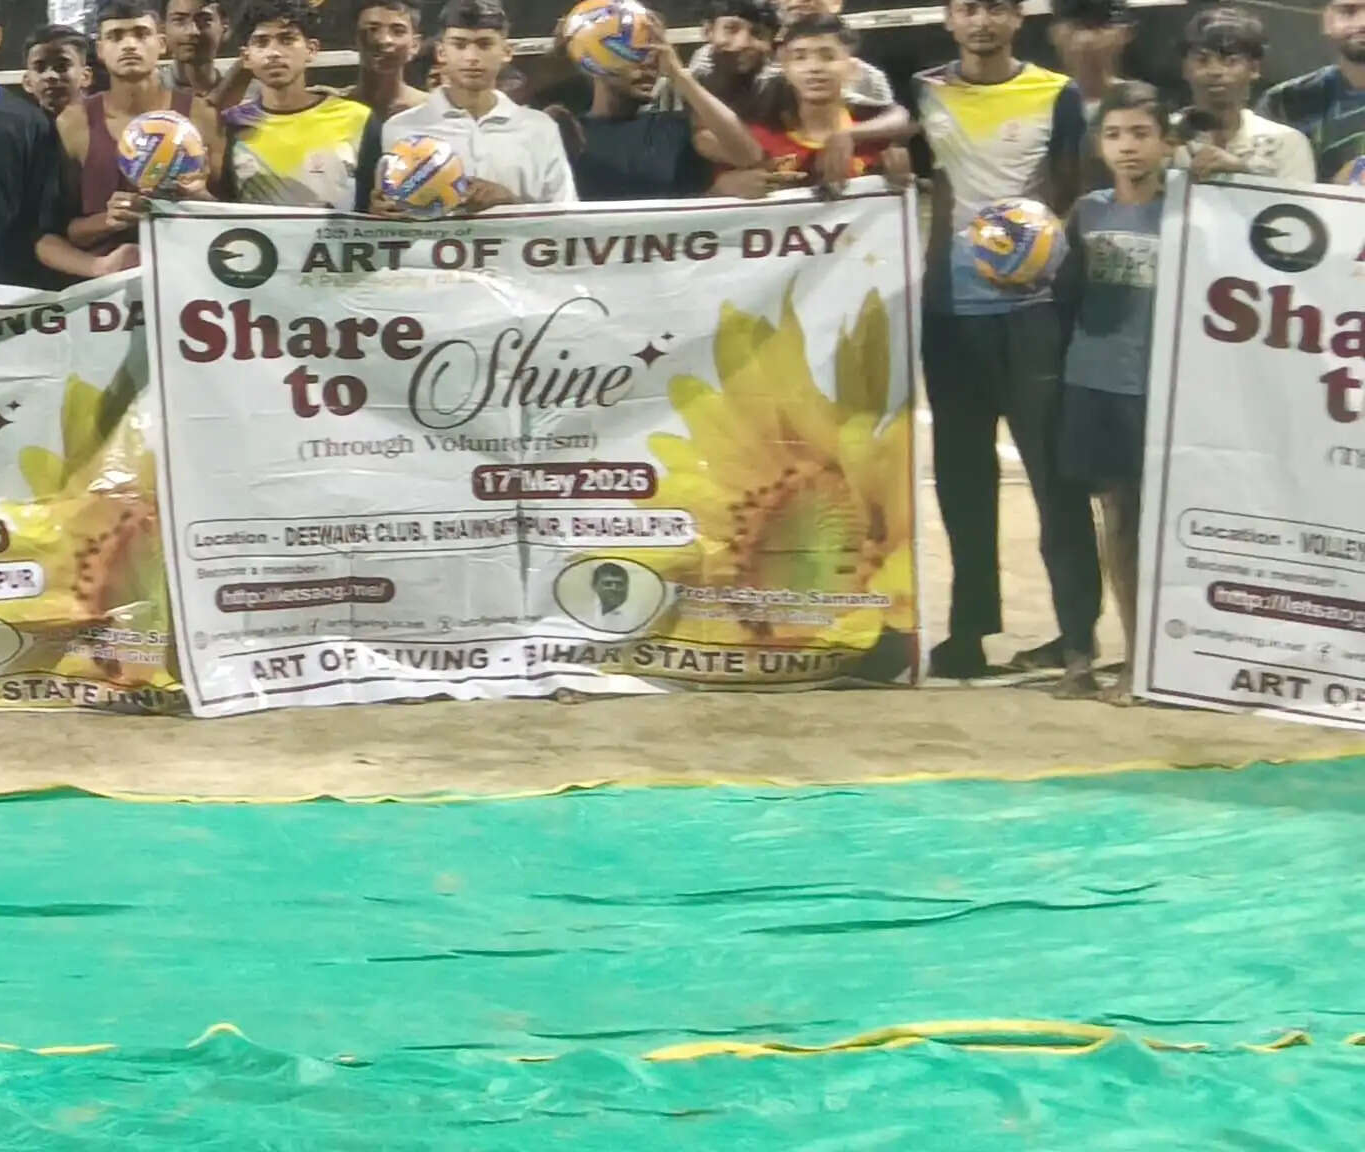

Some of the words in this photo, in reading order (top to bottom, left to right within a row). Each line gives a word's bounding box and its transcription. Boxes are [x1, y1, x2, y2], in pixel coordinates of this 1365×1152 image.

[301, 240, 411, 273] ART
[431, 238, 504, 270] OF
[524, 230, 720, 269] GIVING
[741, 223, 850, 259] DAY
[353, 227, 451, 239] Anniversary
[455, 227, 473, 237] of
[88, 301, 145, 333] DA
[178, 298, 424, 363] Share
[1202, 276, 1365, 359] Sha
[407, 297, 634, 430] Shine
[283, 364, 368, 418] to
[1319, 366, 1365, 423] t
[298, 433, 414, 461] (Through
[523, 469, 578, 497] May
[582, 468, 649, 493] 2026
[194, 531, 268, 547] Location
[252, 654, 306, 679] ART
[319, 648, 357, 671] OF
[633, 644, 744, 673] STATE
[758, 651, 846, 675] UNIT
[2, 679, 98, 702] STATE
[1231, 669, 1312, 700] ART
